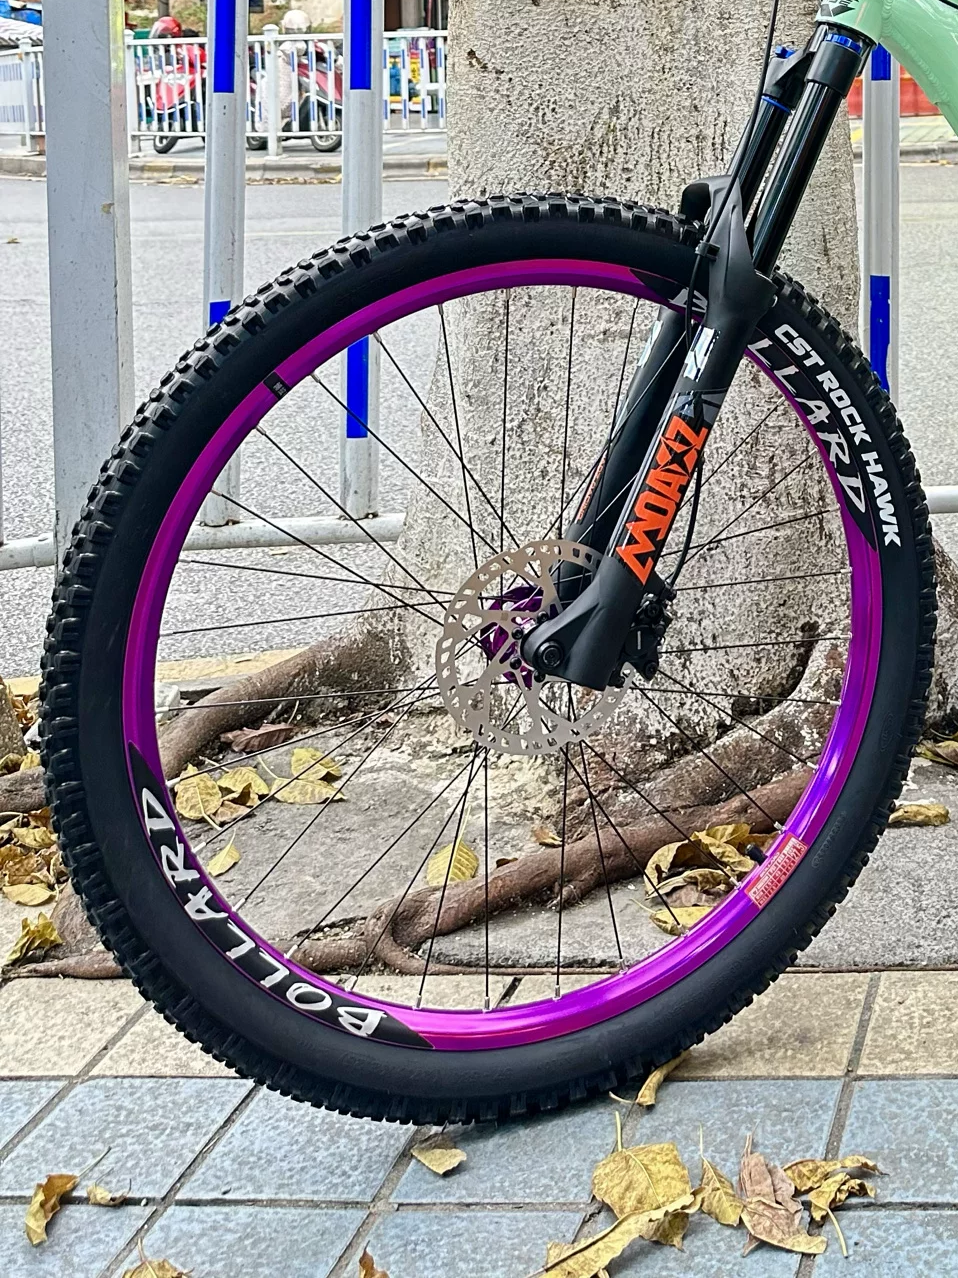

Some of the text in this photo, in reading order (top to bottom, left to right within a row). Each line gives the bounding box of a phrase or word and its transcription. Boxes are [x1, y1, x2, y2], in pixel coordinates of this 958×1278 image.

[774, 323, 902, 548] CST ROCK HAWK
[141, 787, 388, 1038] BOLLARD
